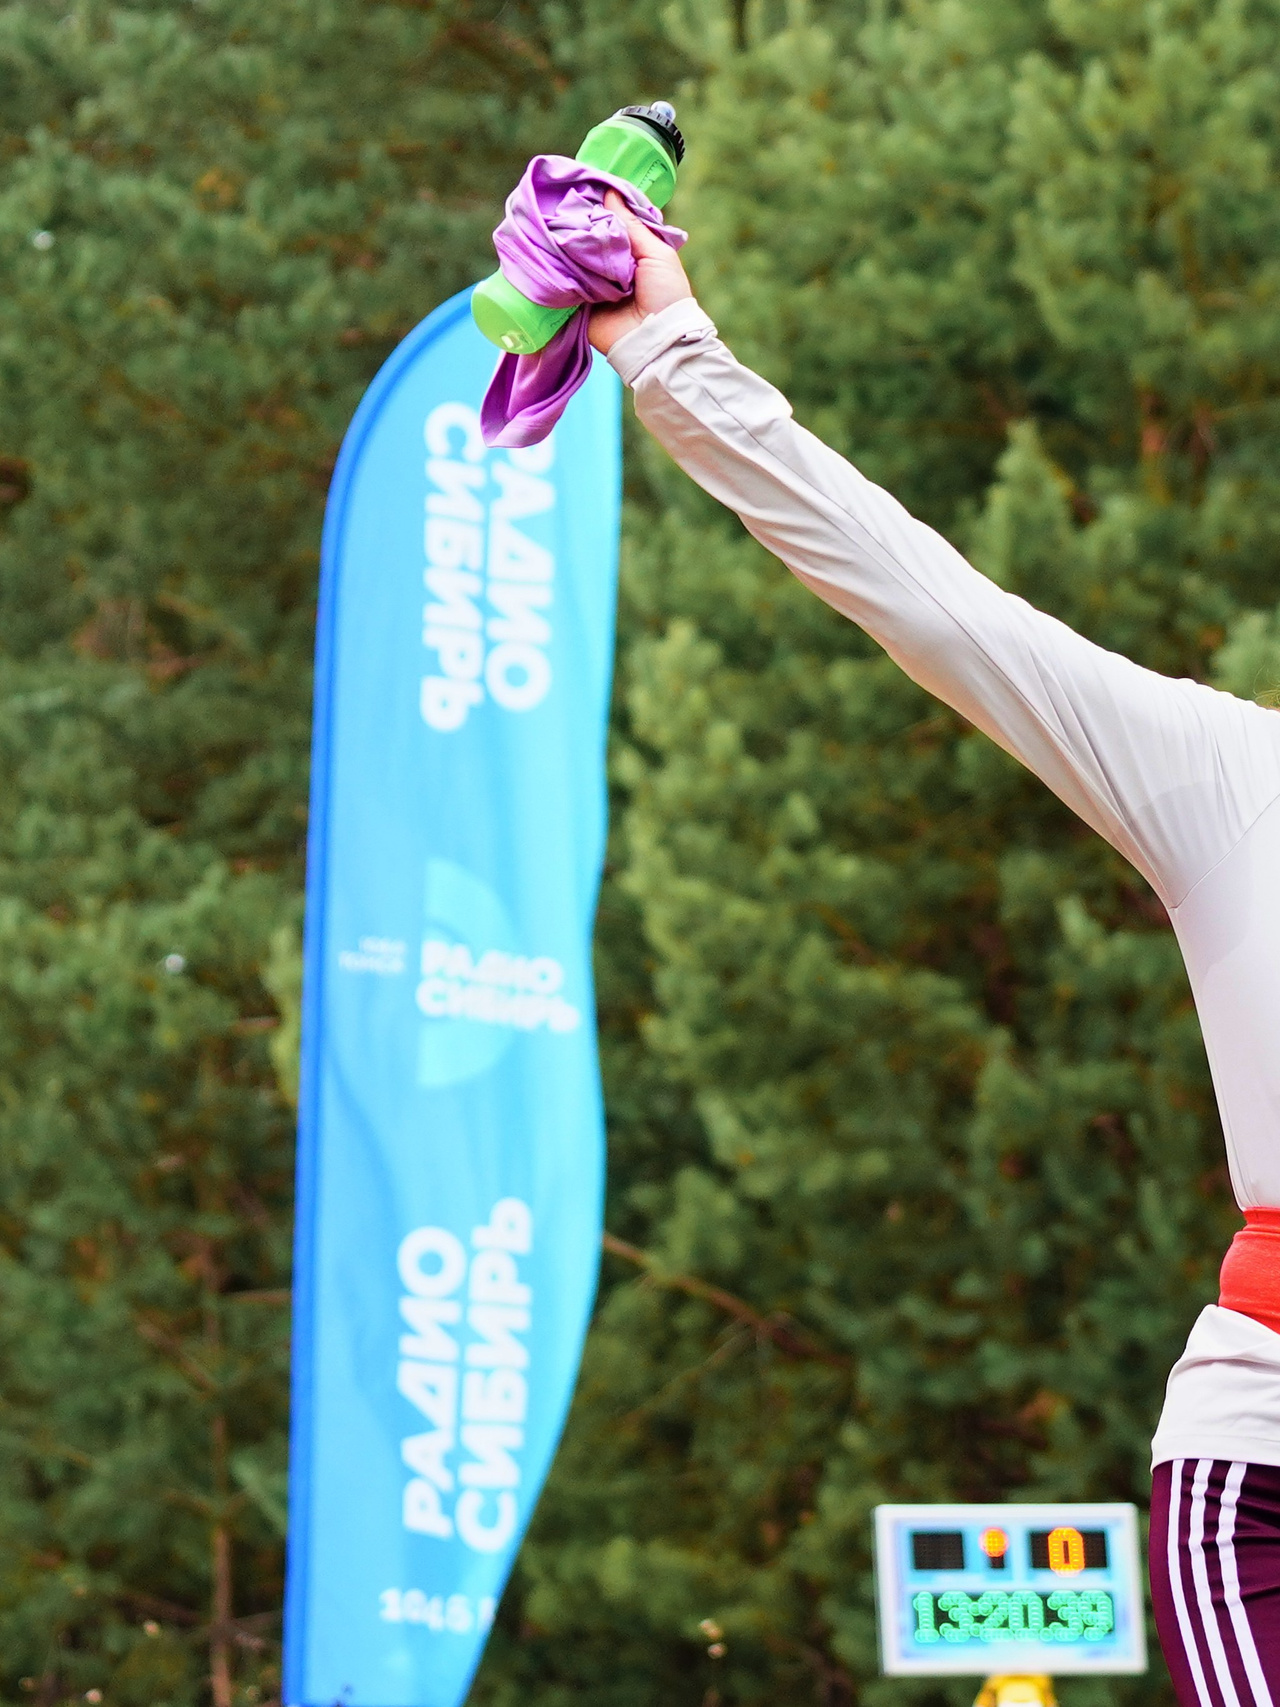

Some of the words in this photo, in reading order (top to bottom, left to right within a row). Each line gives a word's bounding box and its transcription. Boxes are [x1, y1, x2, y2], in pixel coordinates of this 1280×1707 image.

[420, 402, 487, 733] СИБИРЬ
[396, 1225, 467, 1540] РАДИО
[455, 1196, 534, 1553] СИБИРЬ
[1047, 1526, 1086, 1577] 0
